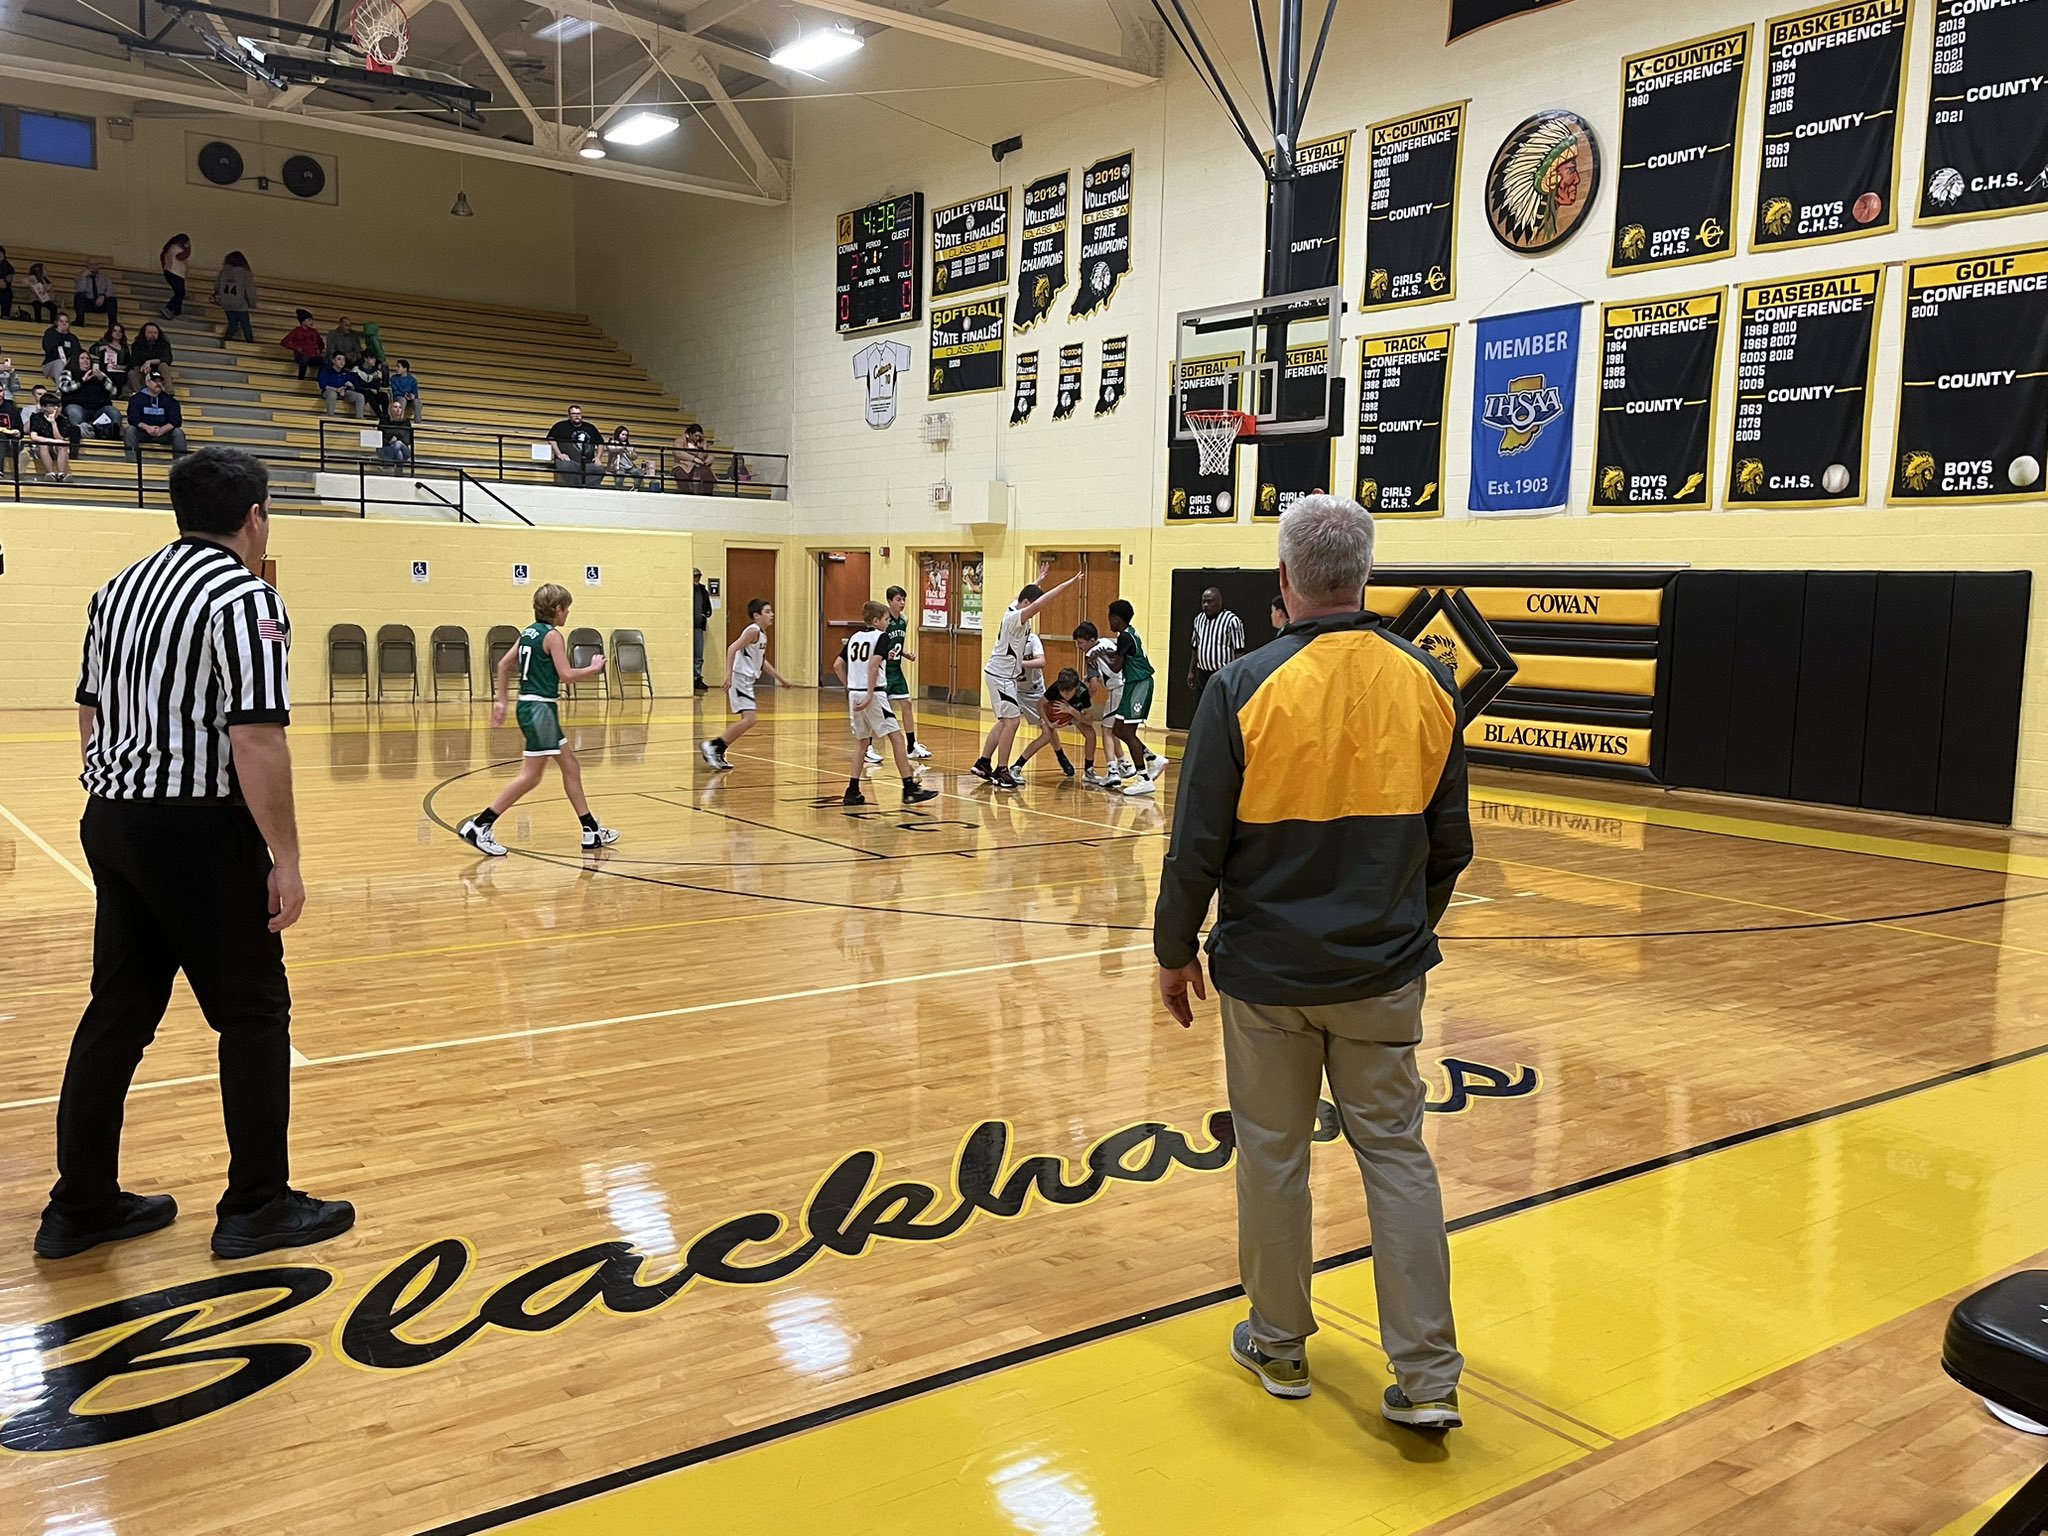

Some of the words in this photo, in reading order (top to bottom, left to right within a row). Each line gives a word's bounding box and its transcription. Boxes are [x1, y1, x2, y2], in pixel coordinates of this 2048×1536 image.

[1776, 0, 1901, 43] BASKETBALL
[1939, 17, 1966, 33] 2019
[1781, 20, 1892, 58] CONFERENCE
[1936, 31, 1966, 47] 2020
[1633, 38, 1740, 79] X-COUNTRY
[1935, 47, 1963, 62] 2021
[1934, 59, 1963, 74] 2022
[1636, 59, 1733, 94] CONFERENCE
[1772, 72, 1796, 88] 1970
[1966, 76, 2044, 102] COUNTY
[1628, 93, 1649, 108] 1980
[1795, 112, 1864, 139] COUNTY
[1935, 109, 1964, 125] 2021
[1377, 112, 1456, 143] X-COUNTRY
[1380, 131, 1451, 157] CONFERENCE
[1765, 142, 1790, 156] 1963
[1647, 145, 1708, 169] COUNTY
[1766, 155, 1788, 169] 2011
[1094, 166, 1121, 185] 2019
[1971, 172, 2024, 192] C.H.S.
[1034, 185, 1057, 203] 2012
[1084, 180, 1129, 210] VOLLEYBALL
[863, 203, 896, 234] 4:38
[935, 194, 1006, 229] VOLLEYBALL
[1025, 198, 1066, 226] VOLLEYBALL
[1389, 202, 1433, 222] COUNTY
[1800, 201, 1844, 220] BOYS
[934, 232, 961, 250] STATE
[964, 213, 1006, 242] FINALIST
[1093, 222, 1117, 241] STATE
[1797, 216, 1843, 234] C.H.S.
[891, 228, 910, 241] GUEST
[1652, 227, 1690, 245] BOYS
[838, 242, 858, 255] COWAN
[948, 243, 976, 258] CLASS
[1033, 238, 1054, 256] STATE
[1082, 235, 1128, 259] CHAMPIONS
[1291, 237, 1323, 253] OUNTY
[1650, 241, 1689, 258] C.H.S.
[1021, 250, 1063, 273] CHAMPIONS
[1956, 258, 2015, 281] GOLF
[866, 266, 881, 276] BONUS
[897, 269, 912, 279] FOULS
[1393, 272, 1422, 287] GIRLS
[837, 284, 851, 293] FOULS
[858, 279, 875, 288] PLAYER
[879, 275, 890, 283] FOUL
[1922, 275, 2048, 304] CONFERENCE
[903, 280, 911, 308] 0
[1392, 285, 1422, 299] C.H.S.
[1758, 278, 1861, 306] BASEBALL
[841, 294, 849, 320] 0
[933, 301, 1003, 330] SOFTBALL
[1632, 301, 1690, 322] TRACK
[1754, 297, 1863, 323] CONFERENCE
[1911, 304, 1939, 319] 2001
[932, 329, 959, 347] STATE
[962, 319, 1003, 343] FINALIST
[1614, 317, 1708, 340] CONFERENCE
[1772, 321, 1797, 334] 2010
[1384, 336, 1427, 353] TRACK
[1485, 330, 1568, 361] MEMBER
[1769, 334, 1797, 347] 2007
[946, 345, 974, 356] CLASS
[1370, 350, 1441, 368] CONFERENCE
[1740, 351, 1767, 364] 2003
[1769, 348, 1794, 362] 2012
[1364, 369, 1380, 379] 1977
[1739, 365, 1766, 377] 2005
[1937, 369, 2016, 390] COUNTY
[1603, 378, 1626, 390] 2009
[1768, 385, 1835, 403] COUNTY
[1485, 389, 1561, 426] IHSAA
[1626, 398, 1683, 414] COUNTY
[1379, 420, 1423, 433] COUNTY
[1360, 445, 1374, 455] 991
[1944, 460, 1993, 476] BOYS
[1488, 481, 1513, 495] Est.
[1516, 478, 1549, 493] 1903
[1631, 475, 1668, 489] BOYS
[1769, 475, 1814, 489] C.H.S.
[1941, 476, 1994, 491] C.H.S.
[1189, 495, 1212, 505] GIRLS
[1279, 492, 1305, 502] GIRLS
[1382, 486, 1412, 498] GIRLS
[1629, 488, 1667, 501] C.H.S.
[1189, 505, 1212, 515] C.H.S.
[1380, 497, 1411, 509] C.H.S.
[1526, 593, 1600, 616] COWAN
[850, 642, 871, 662] 30
[1483, 723, 1629, 756] BLACKHAWKS
